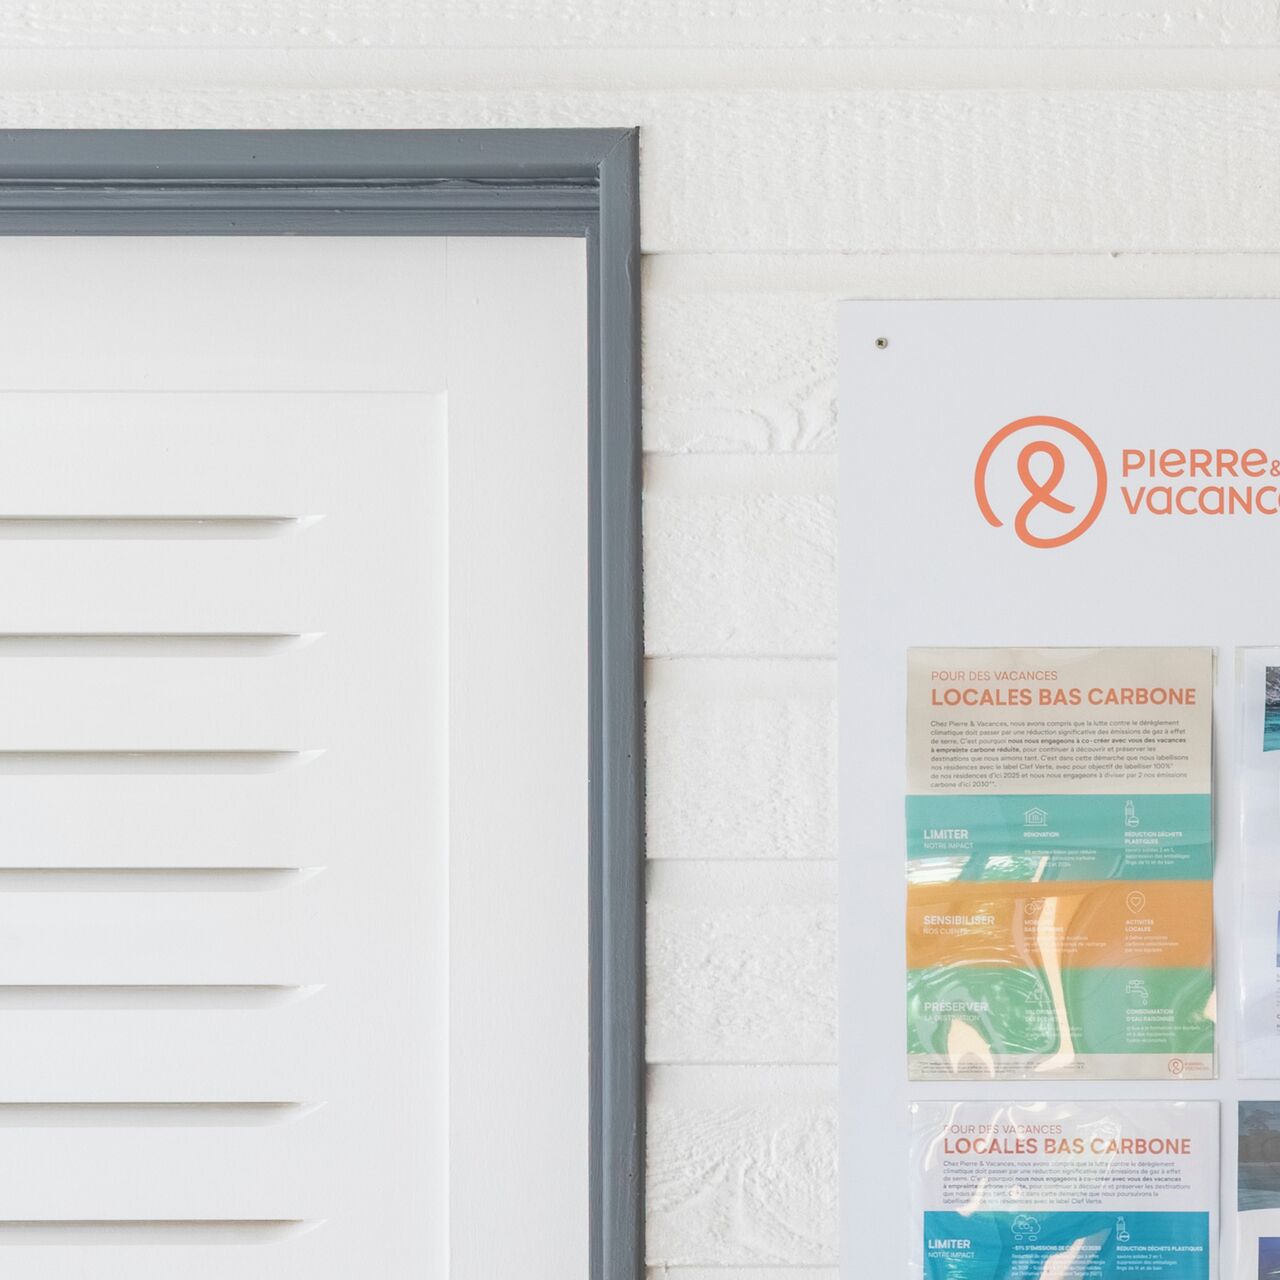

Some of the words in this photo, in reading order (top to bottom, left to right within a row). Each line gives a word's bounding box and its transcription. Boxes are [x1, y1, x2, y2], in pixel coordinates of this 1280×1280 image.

[932, 671, 965, 680] POUR
[969, 671, 990, 680] DES
[994, 671, 1057, 680] VACANCES
[932, 689, 1032, 705] LOCALES
[1039, 688, 1081, 705] BAS
[1088, 688, 1196, 705] CARBONE
[924, 828, 968, 839] LIMITER
[944, 1138, 1038, 1155] LOCALES
[1044, 1138, 1085, 1155] BAS
[1091, 1138, 1192, 1155] CARBONE
[928, 1239, 971, 1249] LIMITER
